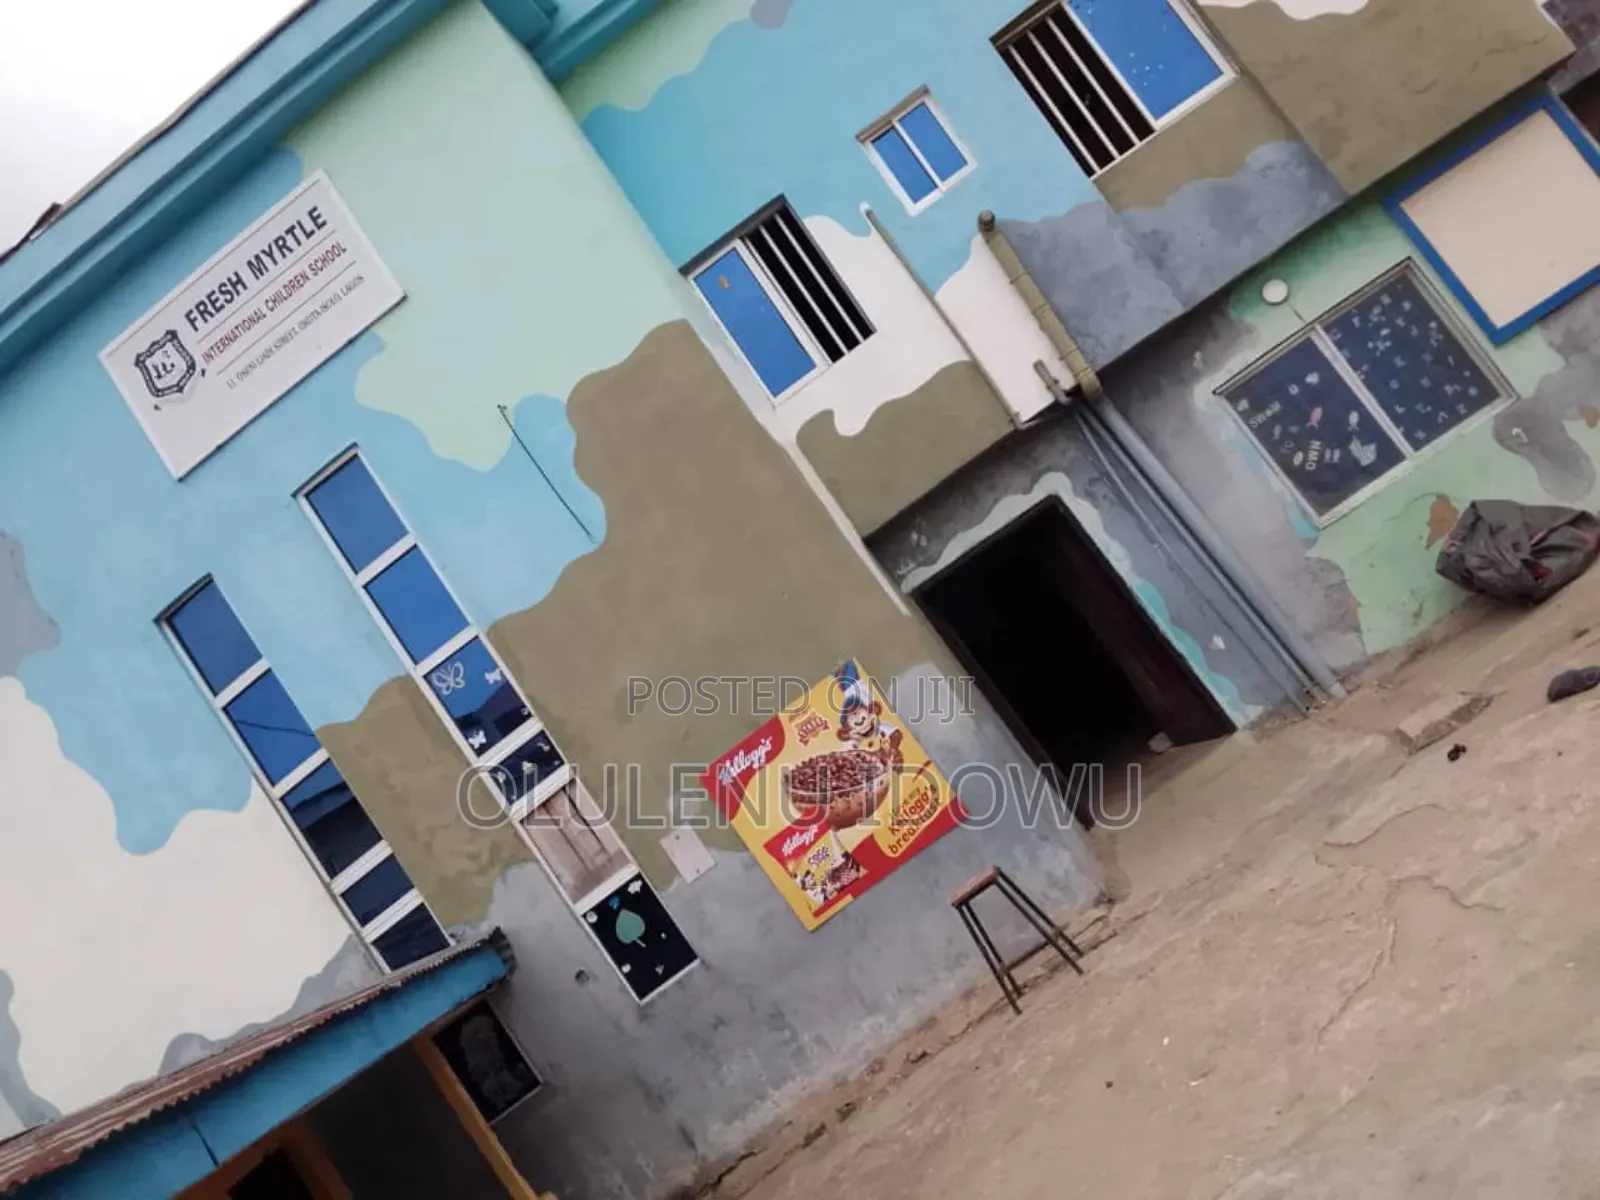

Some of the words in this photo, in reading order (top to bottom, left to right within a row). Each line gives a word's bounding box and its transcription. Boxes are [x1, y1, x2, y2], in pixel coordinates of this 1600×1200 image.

[184, 271, 248, 332] FRESH
[246, 205, 327, 281] MYRTLE
[201, 307, 267, 364] INTERNATIONAL
[264, 268, 310, 313] CHILDREN
[308, 241, 347, 277] SCHOOL
[718, 736, 773, 786] Kellogg's
